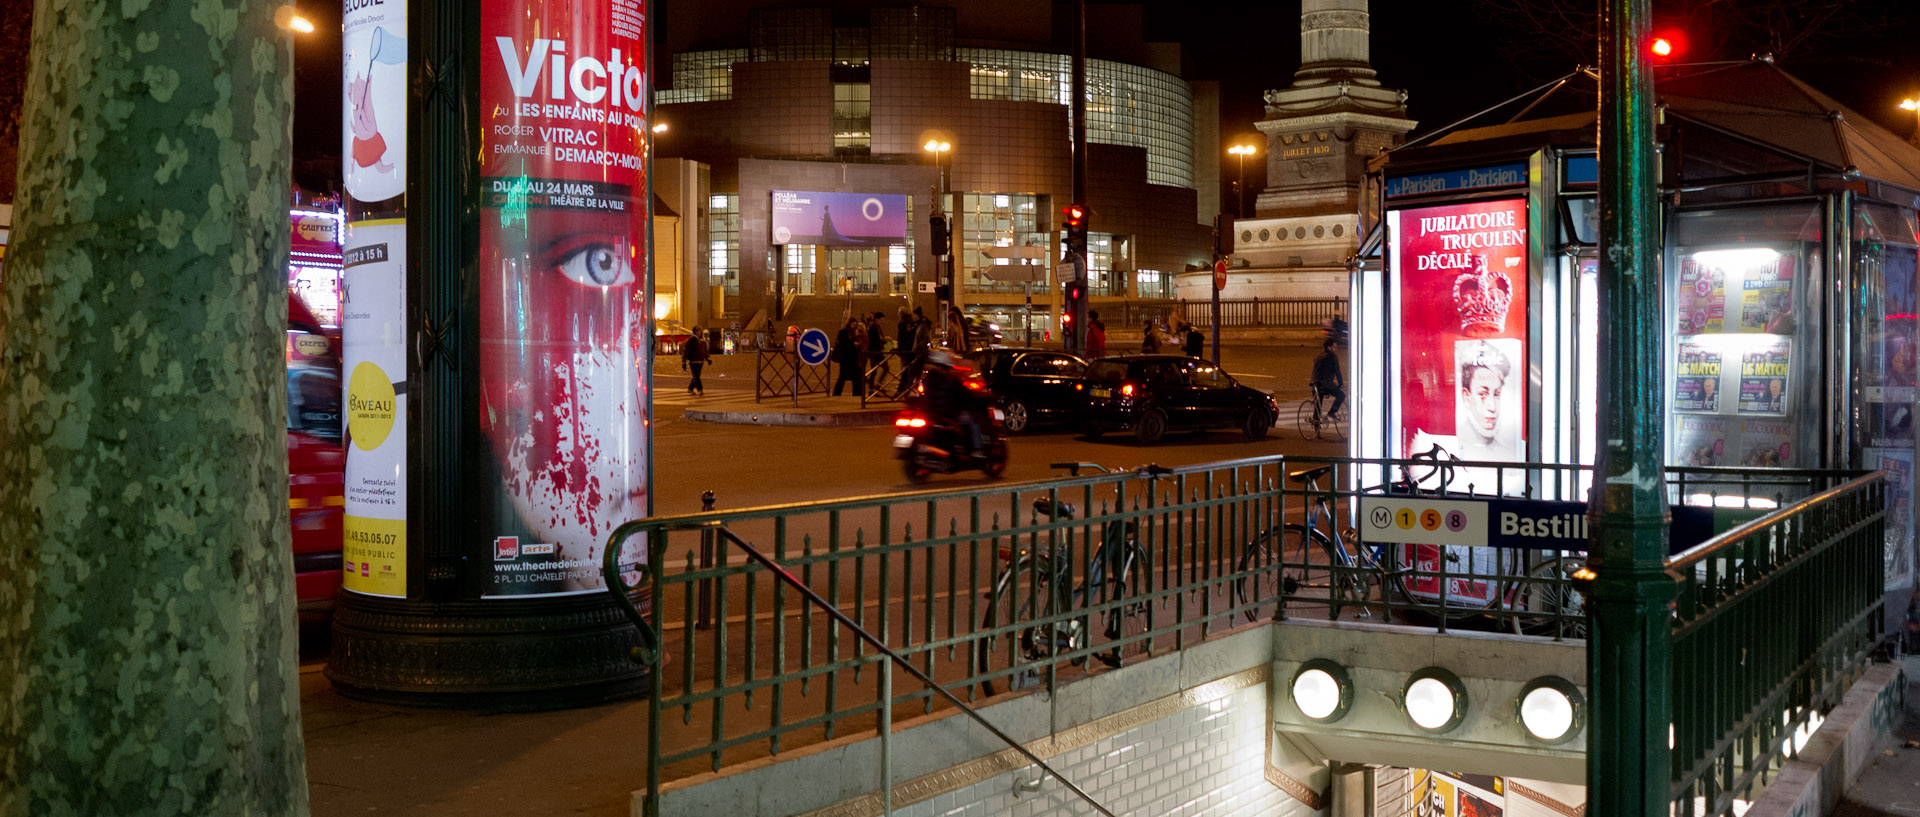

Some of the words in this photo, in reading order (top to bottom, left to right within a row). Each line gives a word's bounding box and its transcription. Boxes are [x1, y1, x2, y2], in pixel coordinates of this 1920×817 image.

[494, 107, 509, 116] OU
[514, 102, 540, 117] LES
[545, 104, 605, 122] ENFANTS
[607, 111, 622, 125] AU
[494, 125, 534, 136] ROGER
[539, 127, 598, 146] VITRAC
[494, 144, 550, 156] EMMANUEL
[554, 147, 642, 170] DEMARCY-MOTA
[1283, 147, 1309, 157] JUILLET
[493, 181, 511, 193] DU
[527, 182, 544, 193] AU
[547, 182, 562, 194] 24
[564, 184, 594, 196] MARS
[1394, 184, 1401, 195] le
[1402, 176, 1446, 194] Parisien
[1461, 176, 1469, 189] le
[1469, 168, 1517, 188] Parisien
[550, 194, 584, 207] THÉÂTRE
[587, 200, 597, 208] DE
[598, 200, 608, 209] LA
[609, 201, 624, 210] VILLE
[1420, 210, 1515, 237] JUBILATOIRE
[360, 249, 364, 261] à
[366, 248, 375, 260] 15
[376, 247, 383, 258] h
[1418, 249, 1472, 270] DÉCALÉ
[1679, 362, 1689, 375] LE
[1690, 362, 1721, 375] MATCH
[1743, 362, 1754, 376] LE
[1755, 362, 1788, 376] MATCH
[1401, 512, 1408, 526] 1
[1426, 513, 1436, 527] 5
[1451, 514, 1460, 528] 8
[1500, 511, 1589, 540] Bastill
[368, 549, 396, 559] PUBLIC
[524, 545, 551, 553] arte
[494, 575, 500, 584] 2
[515, 574, 528, 583] DU
[530, 572, 566, 582] CHÂTELET
